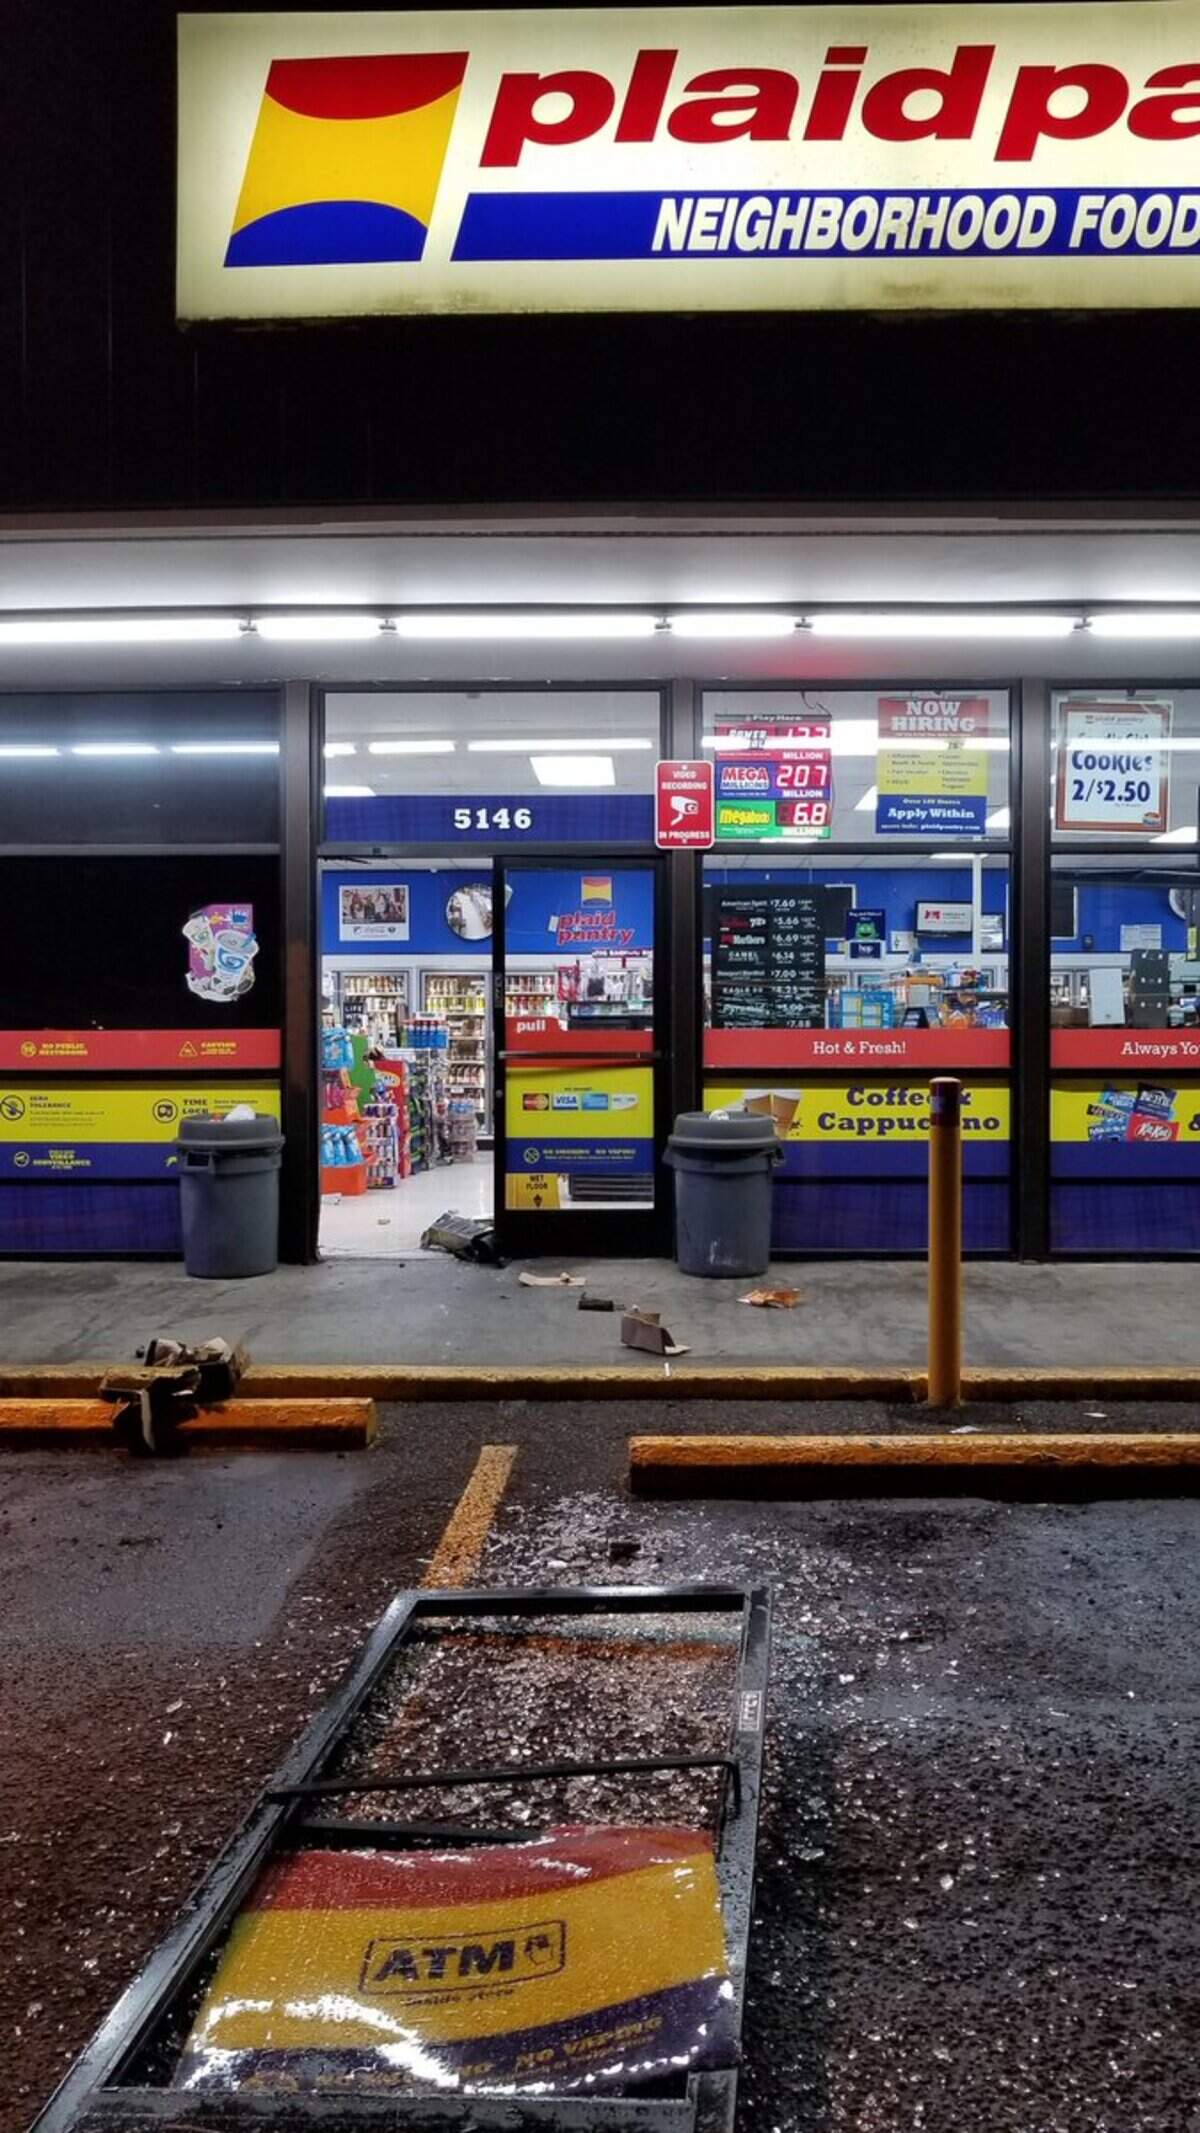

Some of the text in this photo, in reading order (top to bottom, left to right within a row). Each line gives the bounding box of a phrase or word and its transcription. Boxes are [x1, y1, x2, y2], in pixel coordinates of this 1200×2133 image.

[480, 45, 996, 168] plaid
[652, 192, 1200, 252] NEIGHBORHOOD FOOD
[905, 700, 961, 716] NOW
[891, 716, 977, 732] HIRING
[782, 751, 824, 760] MILLION
[672, 770, 697, 779] VIDEO
[721, 765, 828, 786] MEGA 207
[661, 781, 708, 790] RECORDING
[782, 789, 823, 798] MILLION
[1072, 779, 1151, 802] 2/$2.50
[453, 807, 532, 830] 5146
[888, 807, 976, 820] Apply Within
[668, 831, 711, 840] PROGRESS
[559, 911, 616, 930] plaid
[557, 927, 635, 946] pantry
[516, 1019, 546, 1034] pull
[813, 1040, 907, 1055] Hot & Fresh!
[1121, 1041, 1200, 1058] Always Yo
[555, 1096, 577, 1104] VISA
[846, 1086, 932, 1106] Coffe
[817, 1112, 1001, 1136] Cappucno
[526, 1182, 548, 1190] FLOOR
[373, 1940, 516, 1982] ATM
[515, 2048, 554, 2070] NO
[562, 2016, 664, 2056] VAPING
